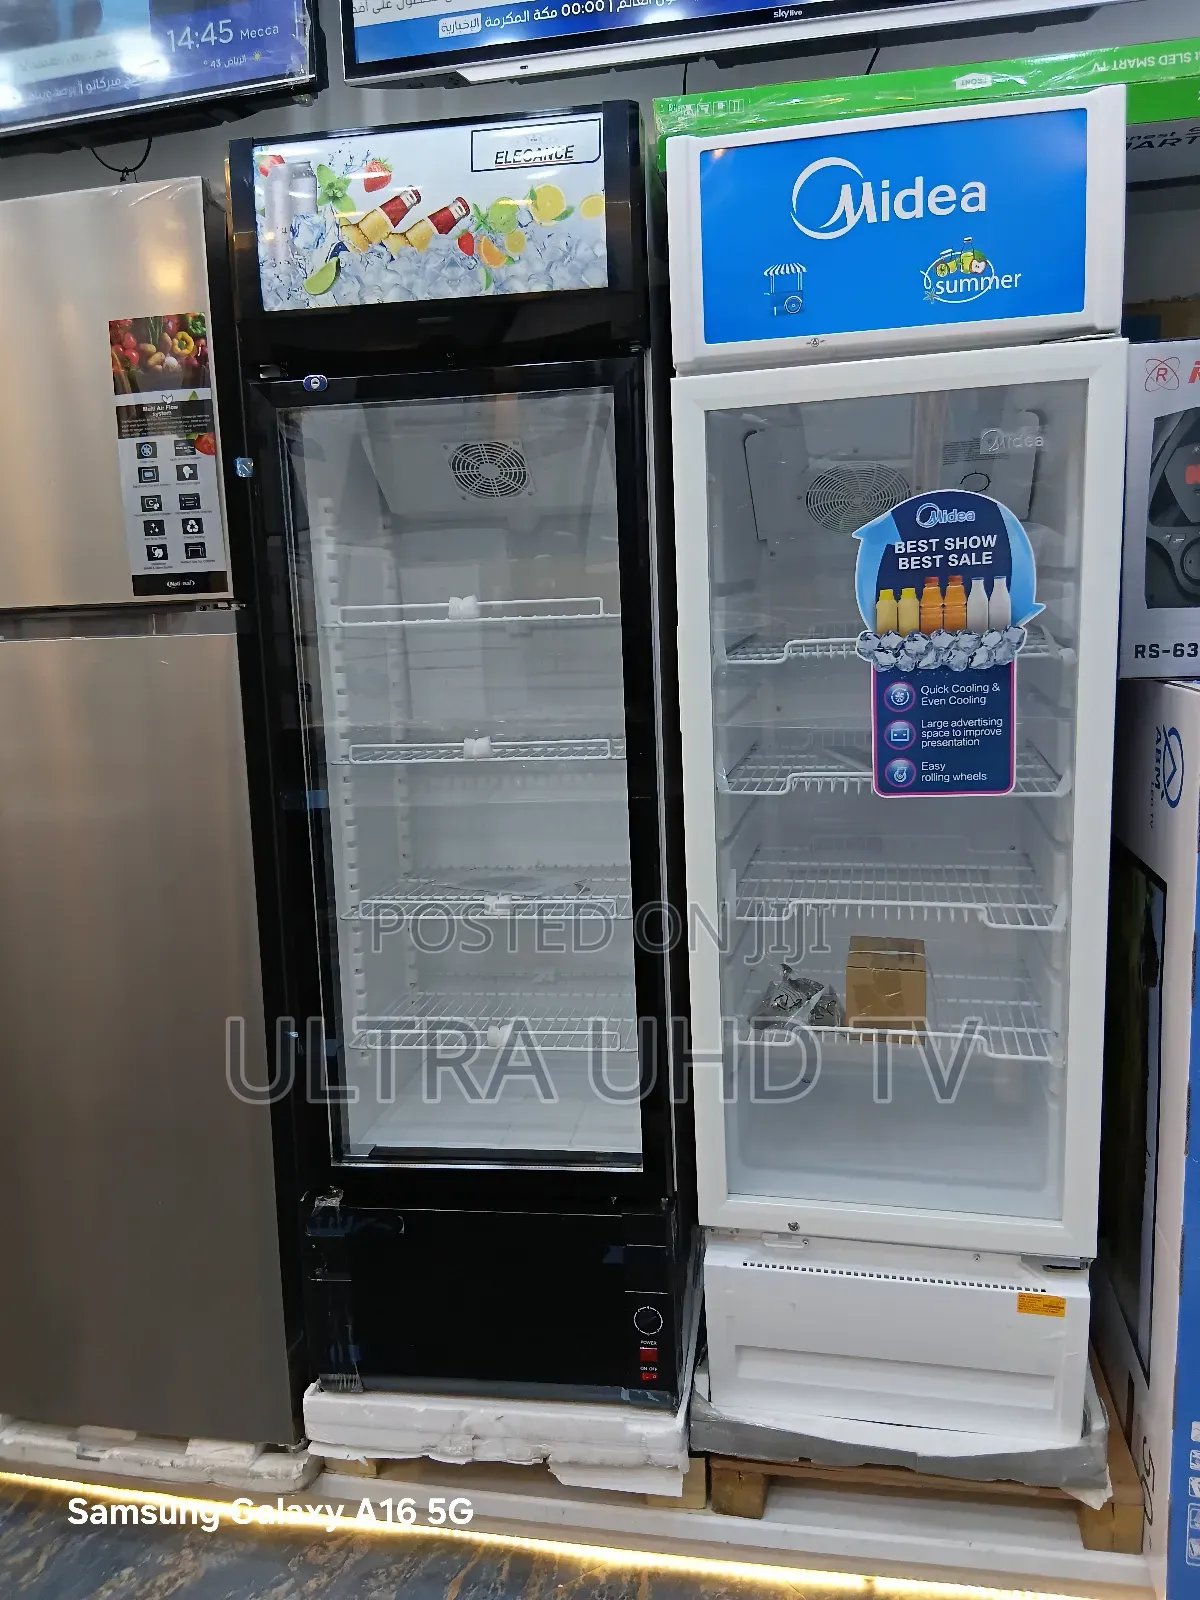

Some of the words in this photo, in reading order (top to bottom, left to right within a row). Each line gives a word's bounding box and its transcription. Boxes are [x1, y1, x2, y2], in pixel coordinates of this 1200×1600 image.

[533, 6, 558, 21] مكة
[561, 1, 605, 17] 00:00
[485, 9, 530, 29] المكرمة
[167, 19, 234, 53] 14:45
[240, 25, 279, 40] Mecca
[1111, 57, 1155, 71] SMART
[1158, 52, 1192, 66] SLED
[1091, 61, 1110, 73] TV
[803, 162, 987, 235] Midea
[935, 272, 1022, 296] summer
[920, 505, 976, 527] Midea
[894, 538, 940, 554] BEST
[944, 534, 998, 551] SHOW
[898, 554, 943, 570] BEST
[947, 551, 993, 567] SALE
[920, 684, 949, 696] Quick
[951, 683, 990, 694] Cooling
[991, 682, 1001, 692] &
[921, 697, 946, 706] Even
[948, 695, 987, 706] Cooling
[921, 719, 949, 730] Large
[950, 717, 1003, 728] advertising
[921, 729, 950, 739] space
[952, 728, 962, 737] to
[963, 727, 1002, 738] improve
[921, 738, 980, 749] presentation
[921, 761, 946, 772] Easy
[921, 772, 950, 782] rolling
[952, 772, 987, 781] wheels
